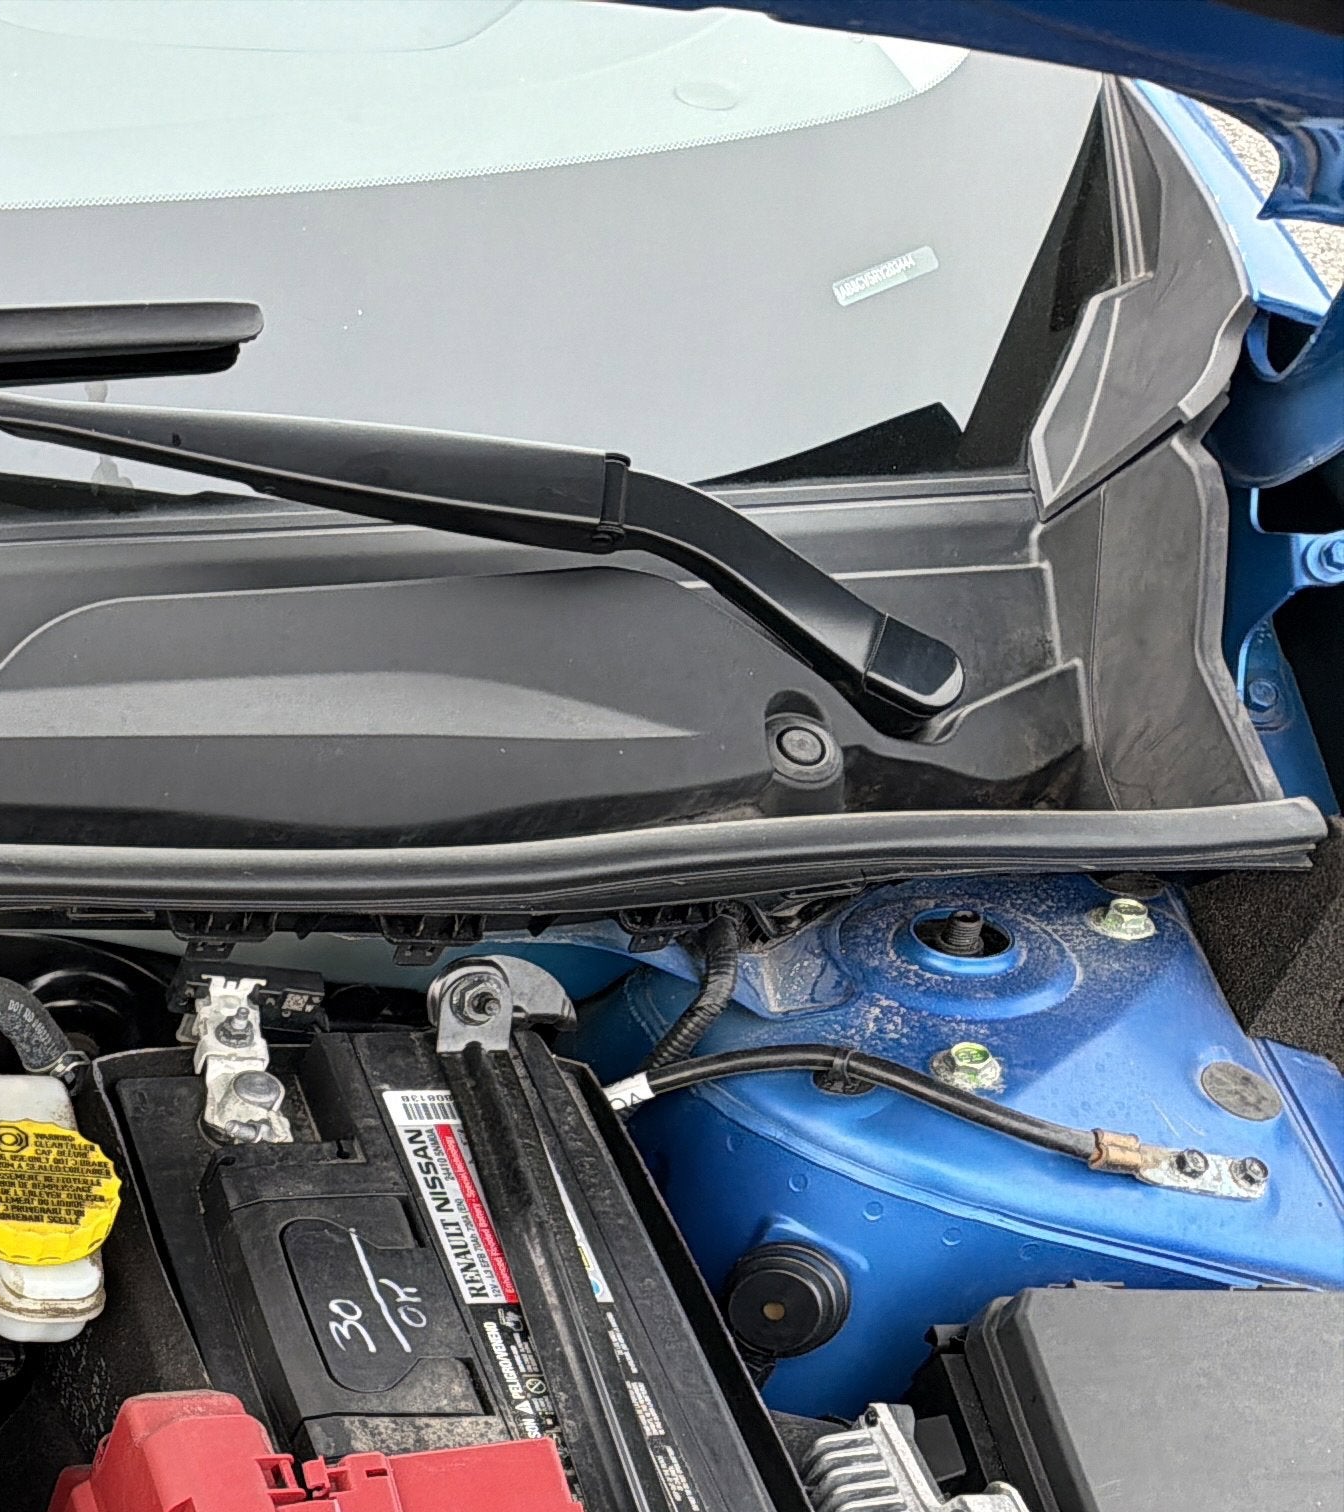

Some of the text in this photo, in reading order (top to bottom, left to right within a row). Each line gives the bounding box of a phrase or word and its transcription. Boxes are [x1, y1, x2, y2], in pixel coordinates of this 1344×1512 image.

[404, 1129, 490, 1299] RENAULT NISSAN
[329, 1299, 377, 1353] 30
